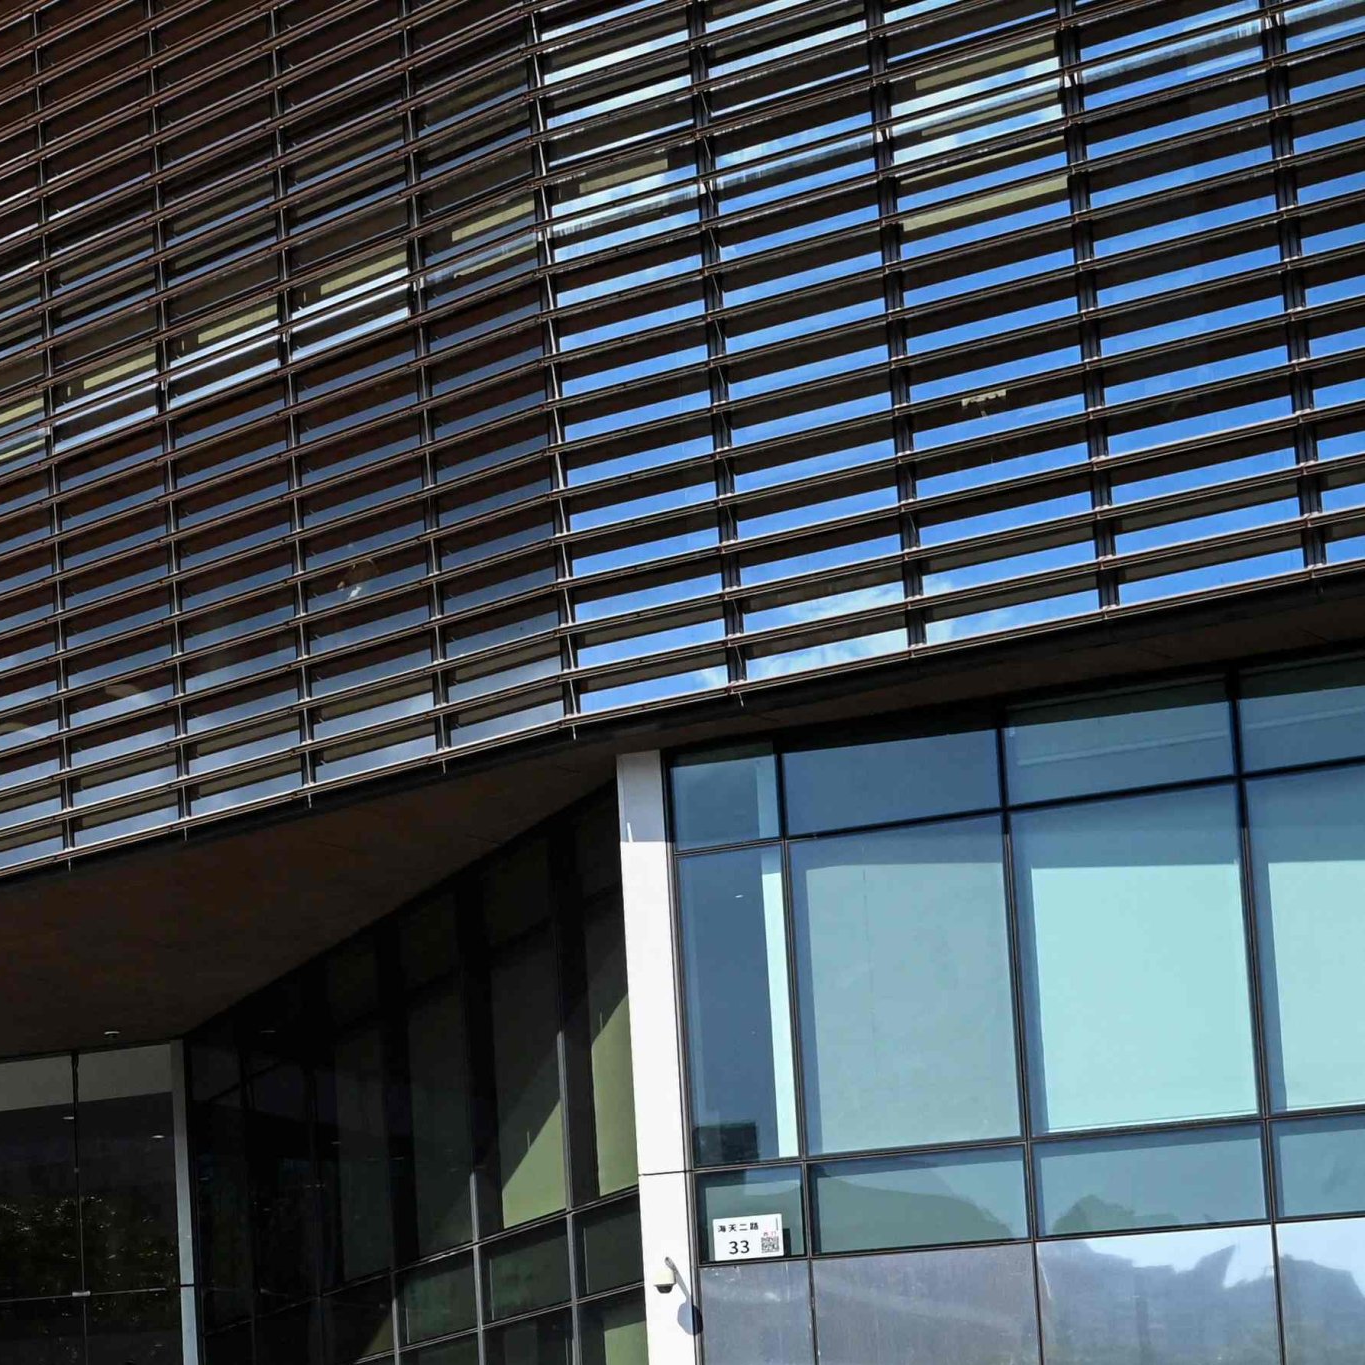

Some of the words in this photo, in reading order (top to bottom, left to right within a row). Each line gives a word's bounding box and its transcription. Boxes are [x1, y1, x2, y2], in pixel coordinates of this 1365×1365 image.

[718, 1222, 759, 1233] 海天二路
[728, 1240, 750, 1255] 33
